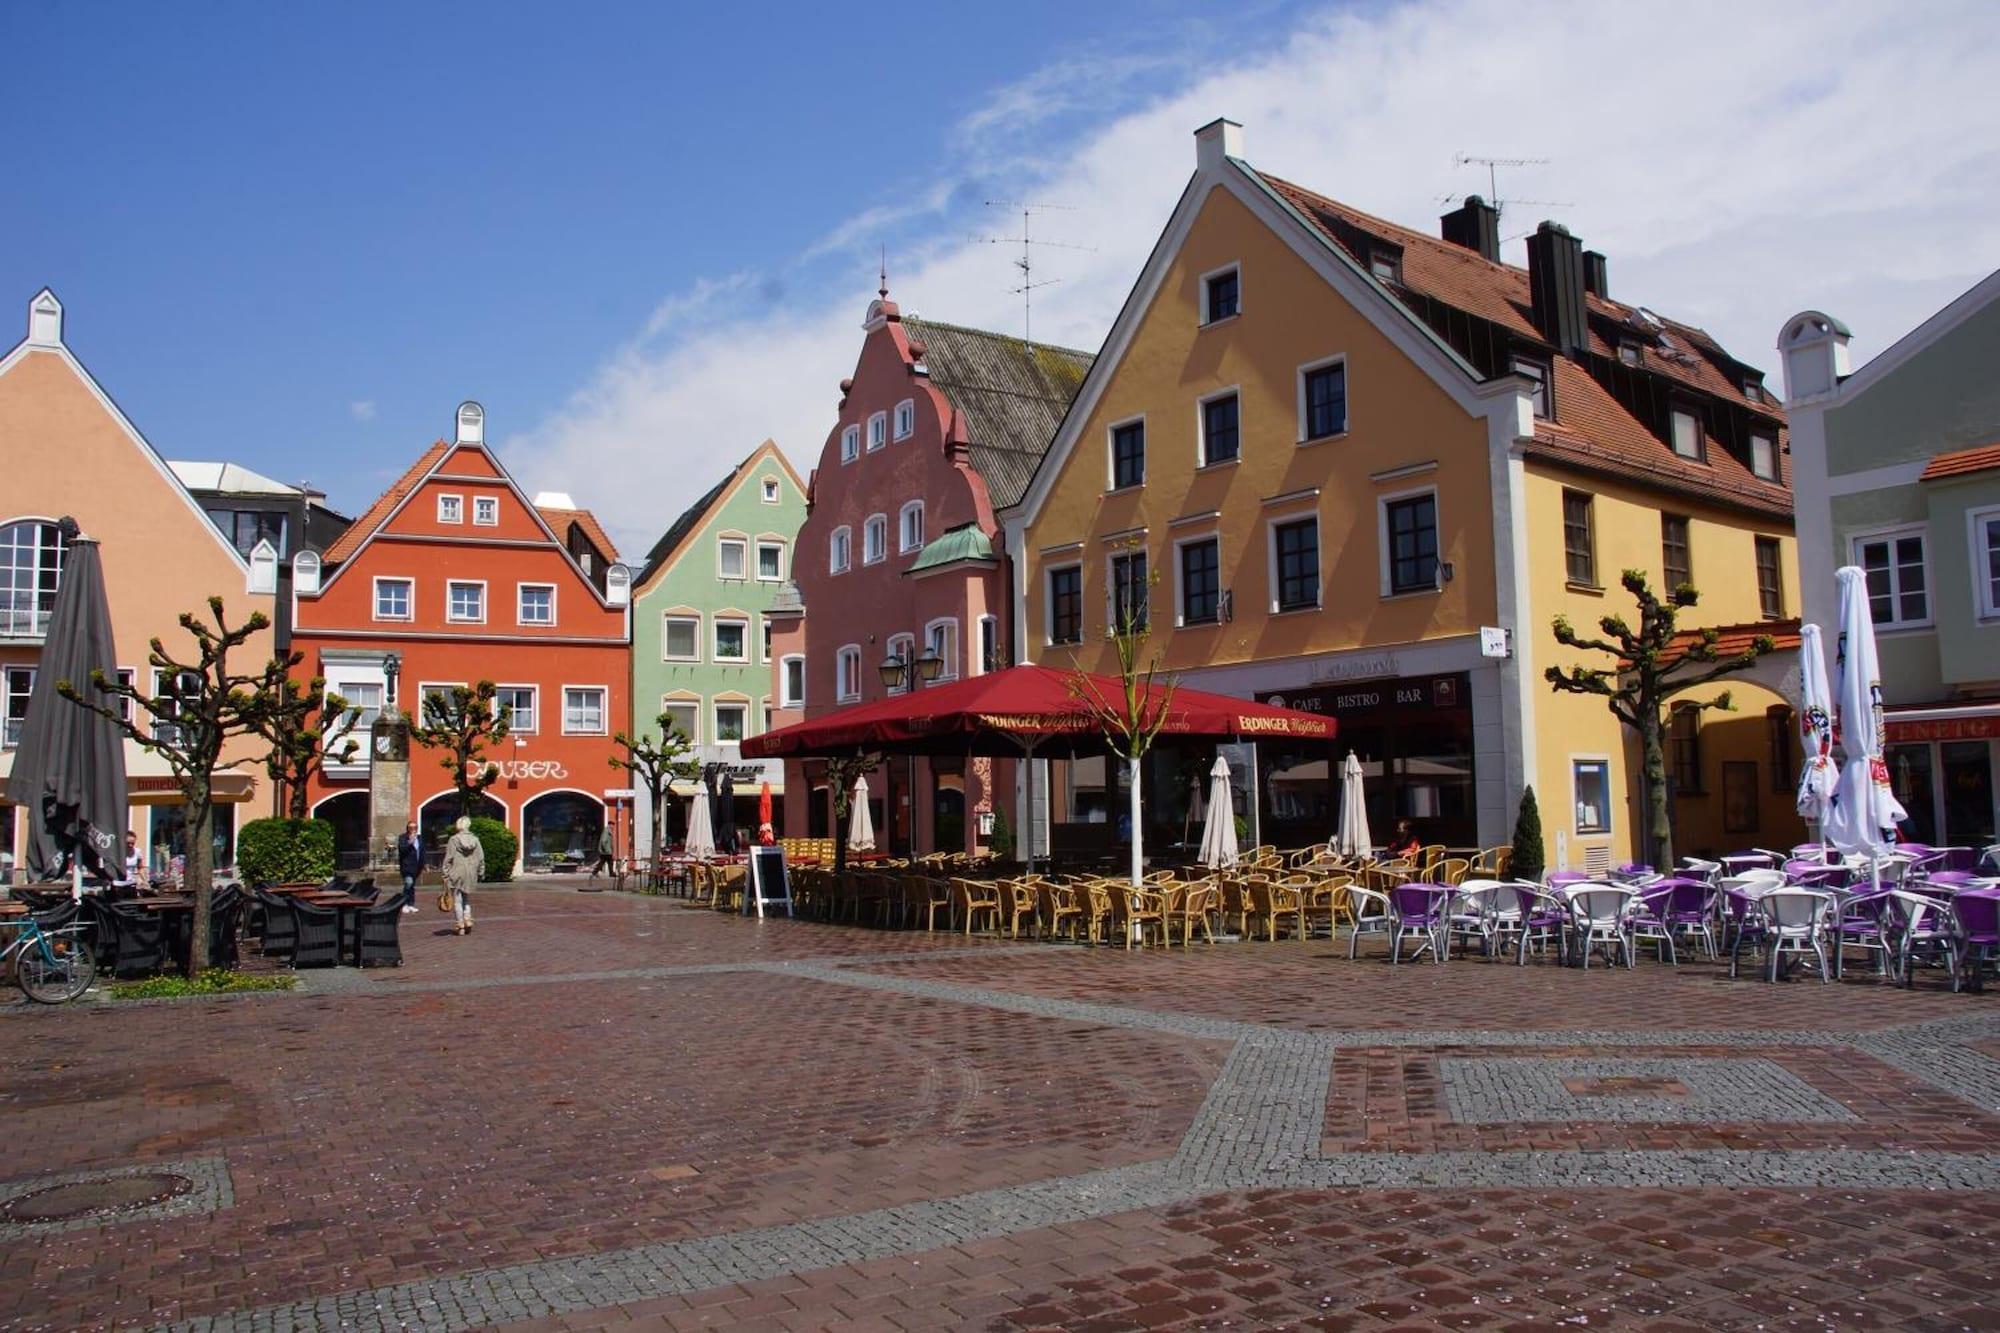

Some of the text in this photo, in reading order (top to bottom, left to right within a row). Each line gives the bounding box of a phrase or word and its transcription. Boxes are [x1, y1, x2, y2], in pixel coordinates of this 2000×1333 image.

[1337, 692, 1380, 709] BISTRO
[1396, 688, 1423, 704] BAR
[1239, 715, 1290, 732] ERDINGER
